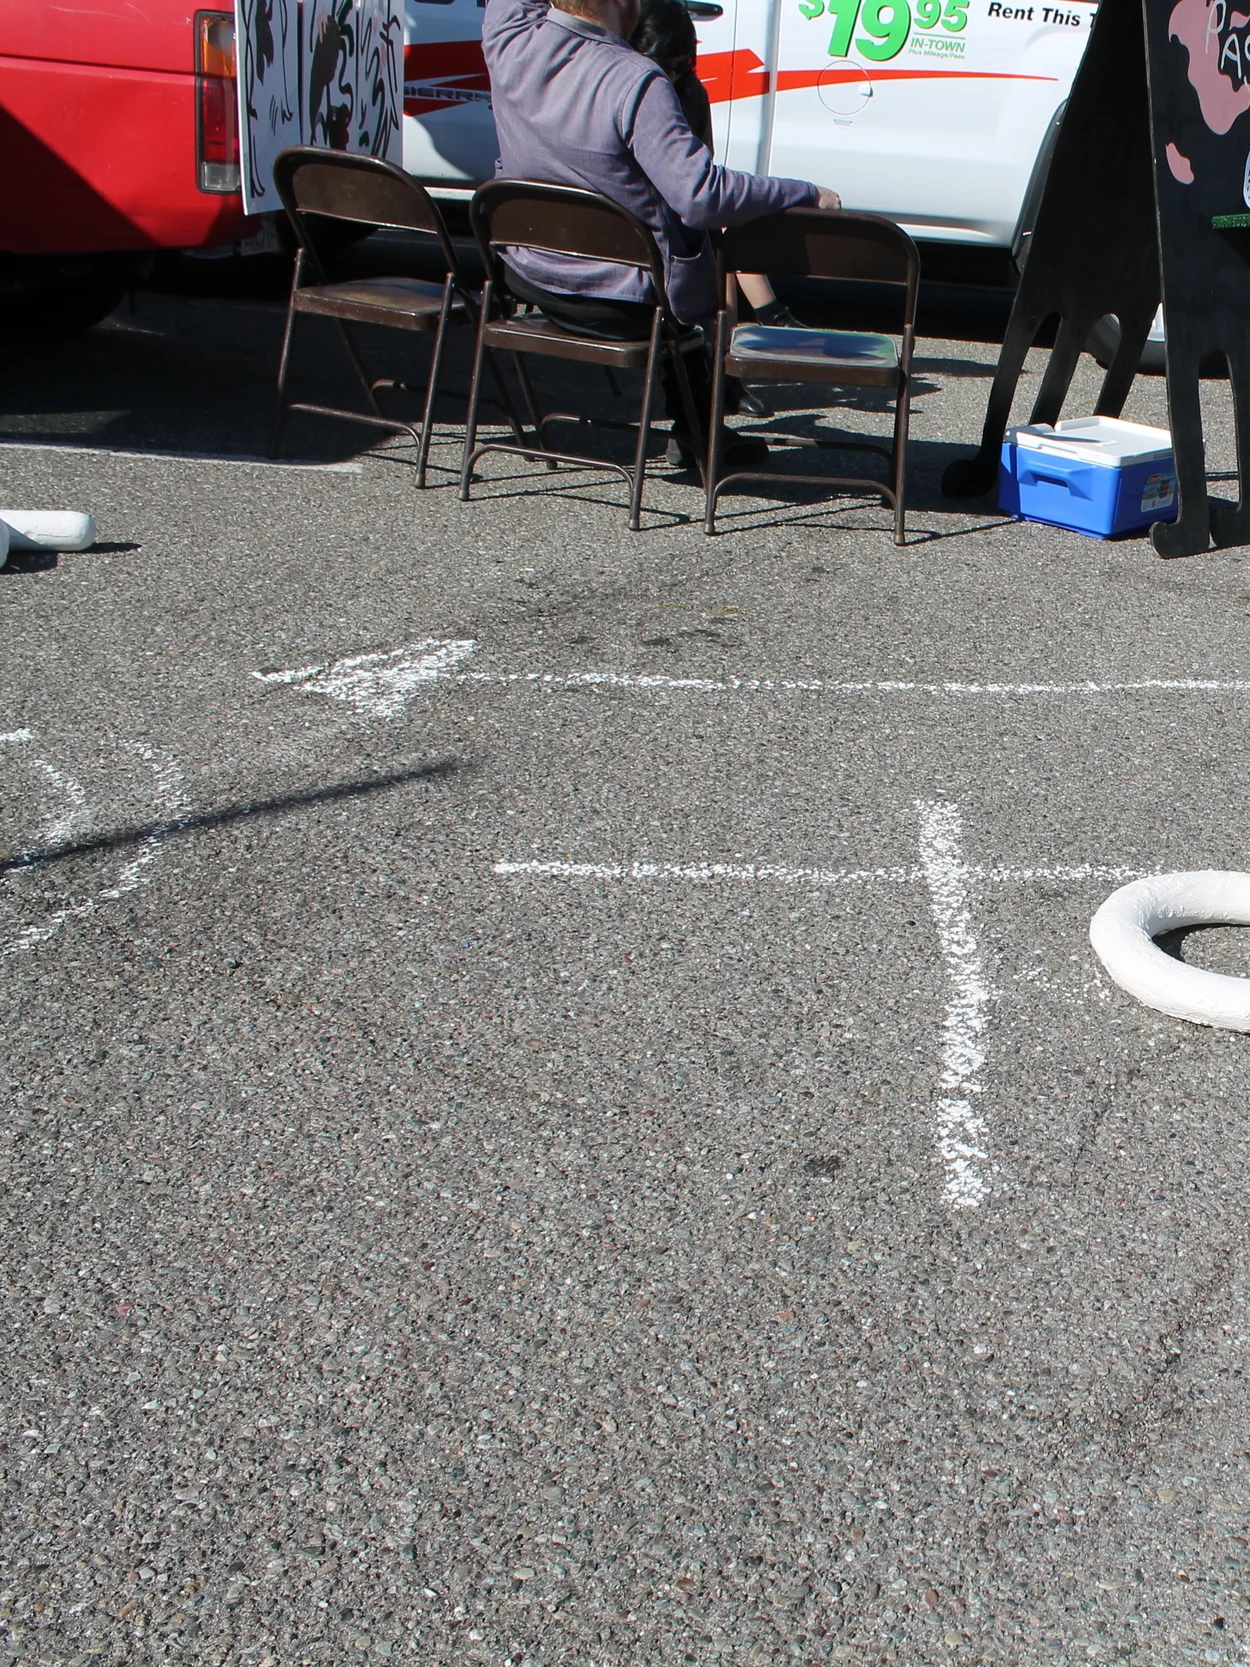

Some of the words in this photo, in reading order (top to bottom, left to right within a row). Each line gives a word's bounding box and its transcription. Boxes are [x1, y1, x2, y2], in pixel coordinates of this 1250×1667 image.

[987, 1, 1034, 21] Rent
[1041, 7, 1081, 27] This
[910, 37, 966, 53] IN-TOWN
